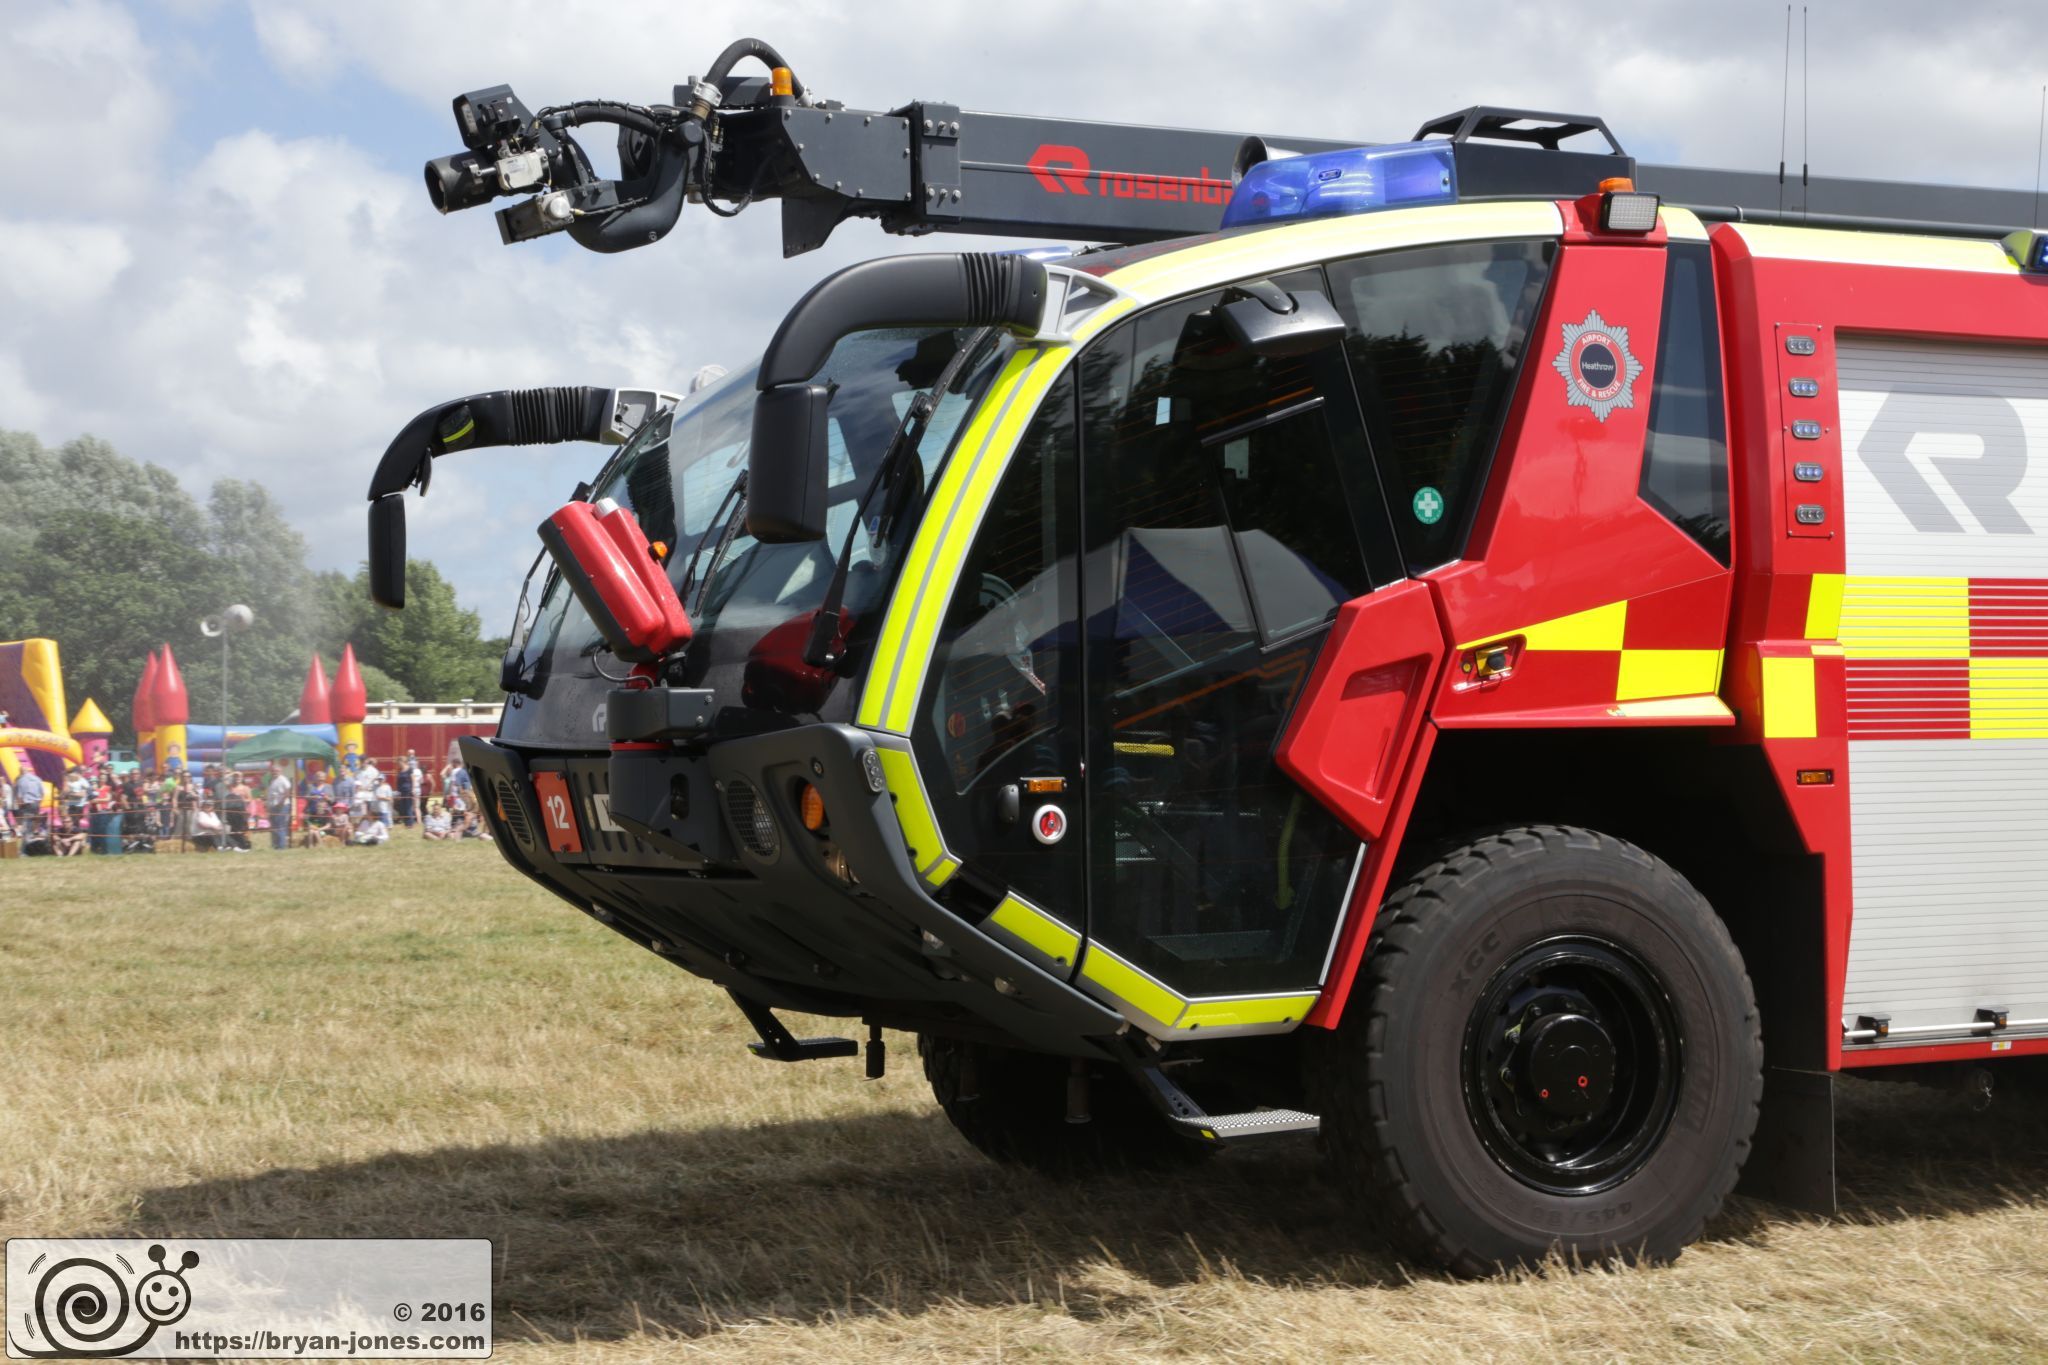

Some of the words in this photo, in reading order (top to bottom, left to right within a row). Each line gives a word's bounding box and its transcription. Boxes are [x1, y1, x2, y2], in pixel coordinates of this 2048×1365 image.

[1581, 334, 1611, 346] AIRPORT
[1581, 361, 1614, 371] Heathrow
[1577, 378, 1591, 394] FIRE
[1598, 380, 1621, 399] RESCUE
[1857, 383, 2036, 535] R
[546, 795, 570, 829] 12
